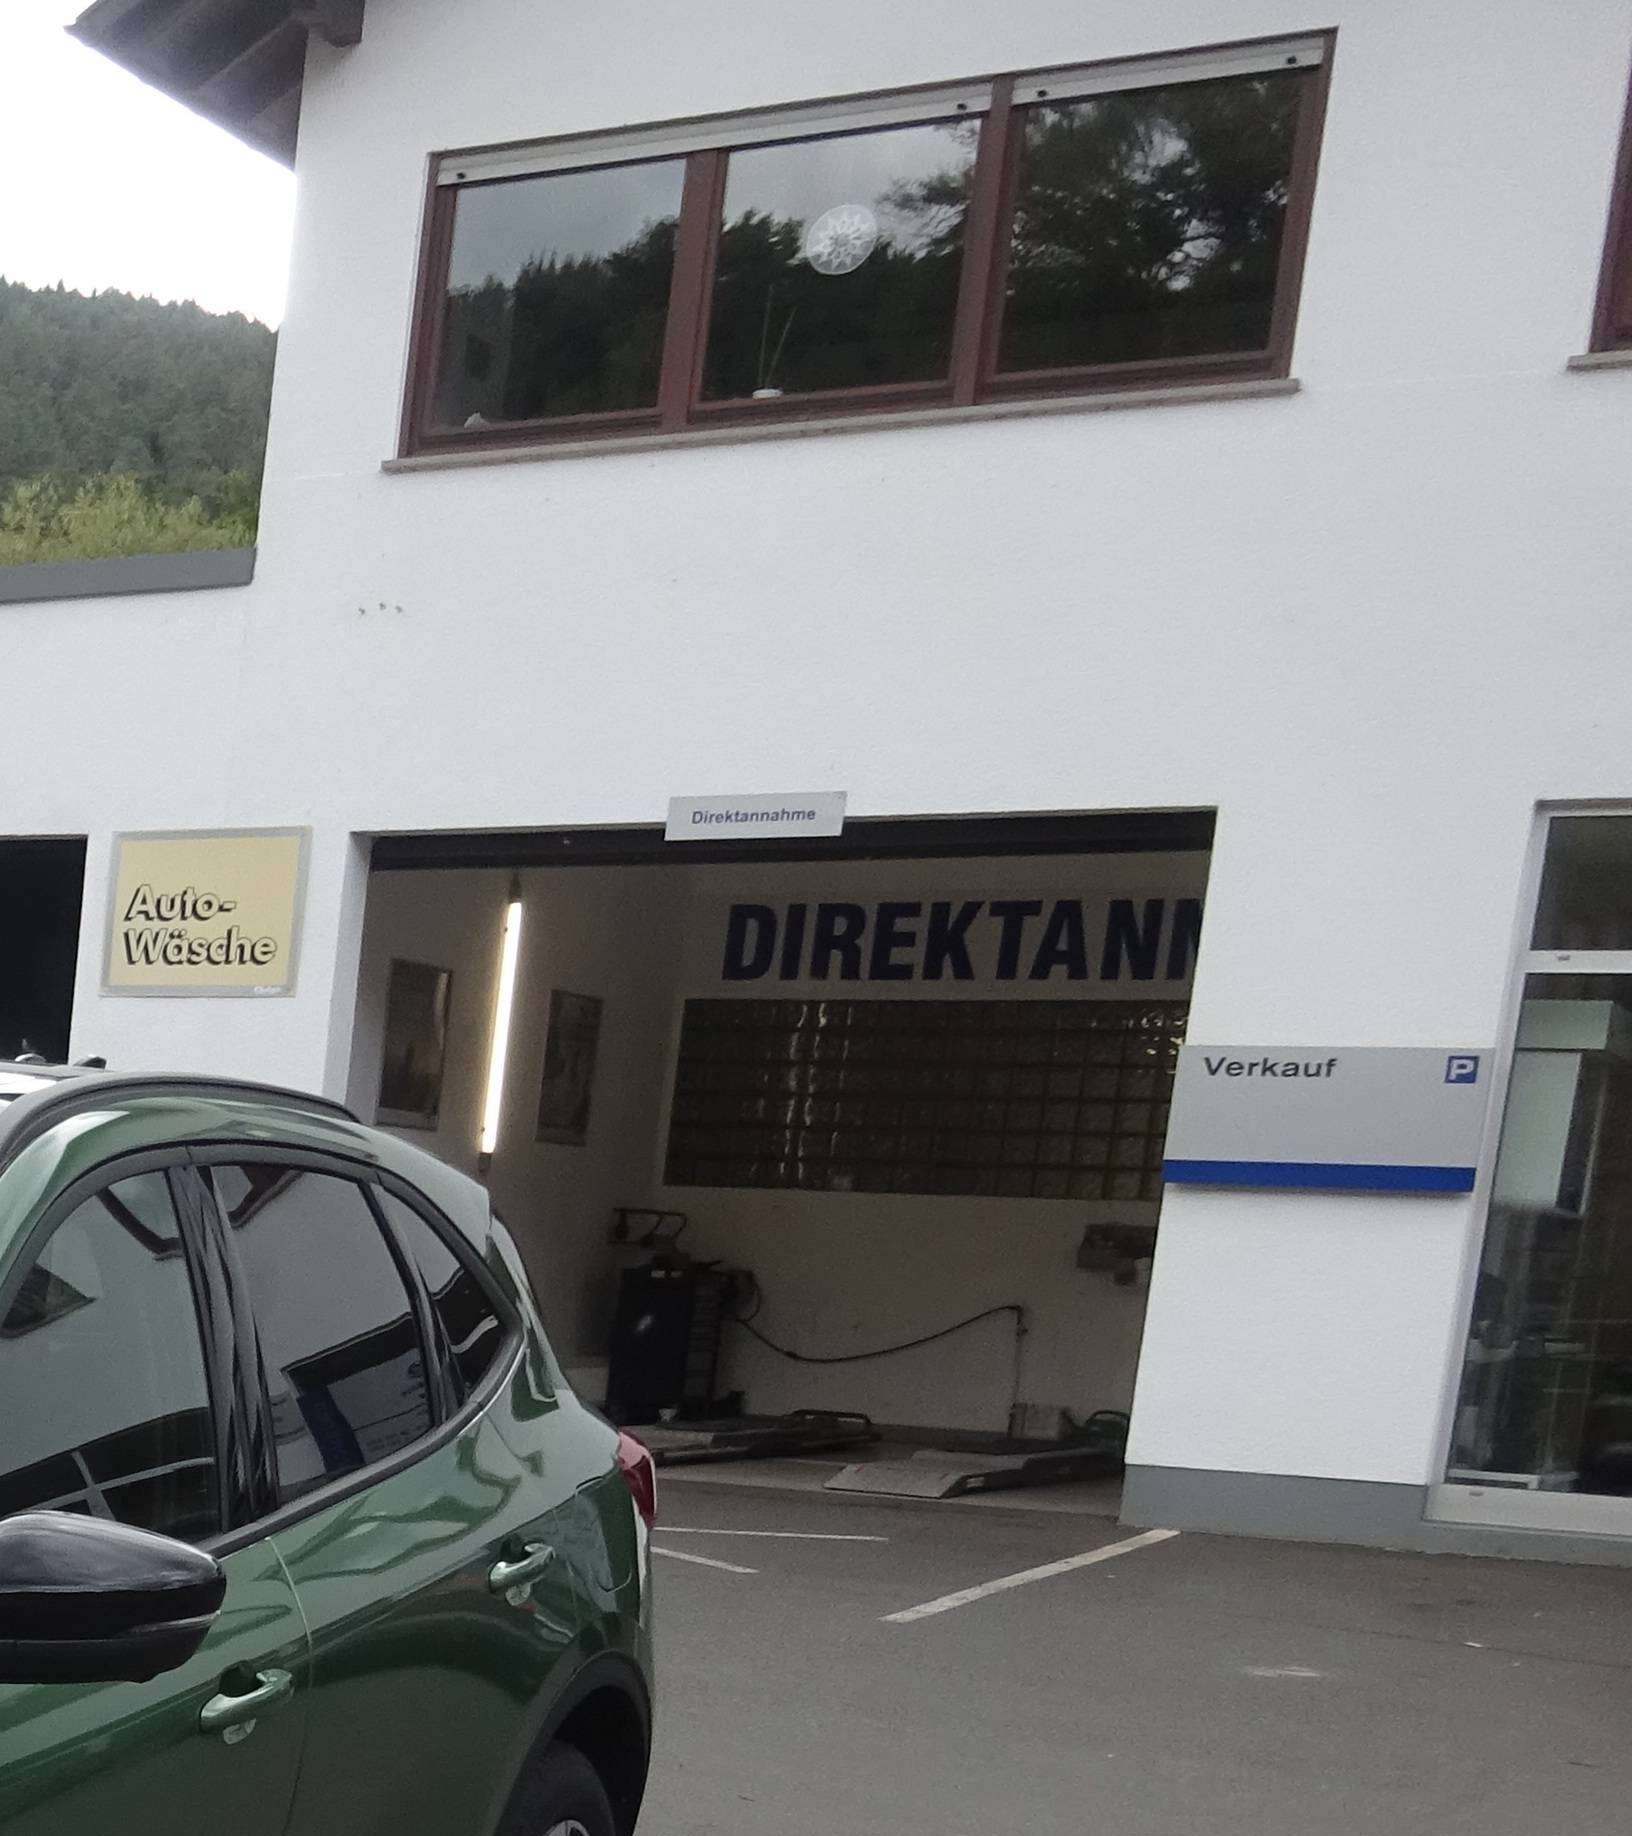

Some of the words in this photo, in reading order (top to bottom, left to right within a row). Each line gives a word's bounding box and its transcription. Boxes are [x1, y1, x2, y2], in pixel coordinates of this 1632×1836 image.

[692, 808, 816, 824] Direktannahme
[123, 884, 237, 921] Auto-
[123, 925, 277, 965] Wäsche
[1203, 1057, 1338, 1078] Verkauf
